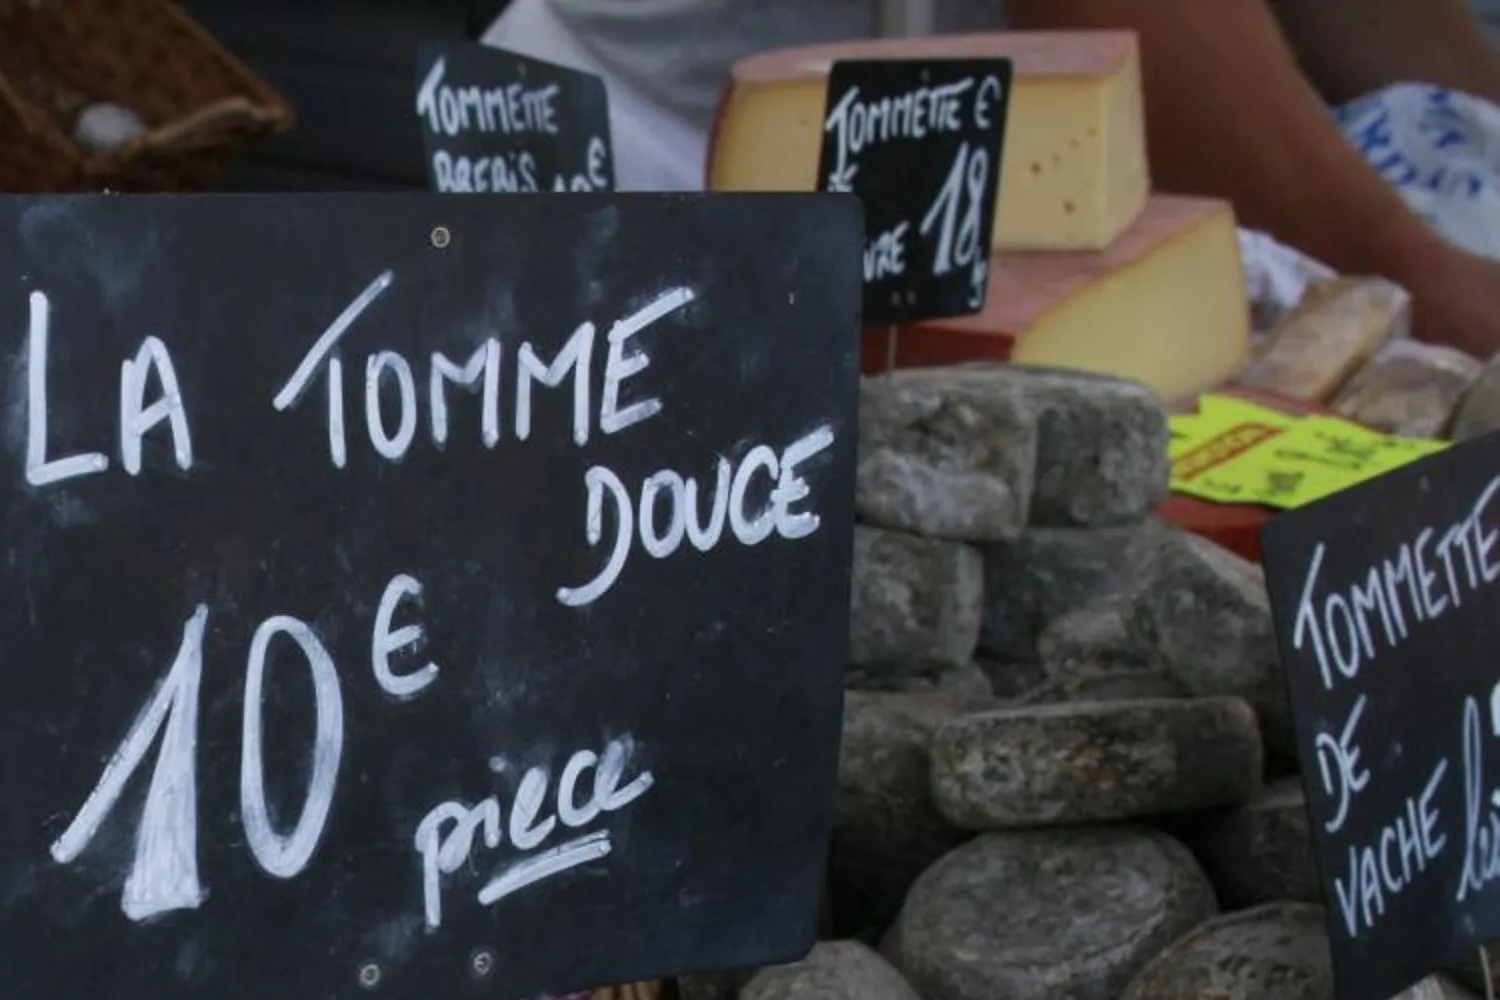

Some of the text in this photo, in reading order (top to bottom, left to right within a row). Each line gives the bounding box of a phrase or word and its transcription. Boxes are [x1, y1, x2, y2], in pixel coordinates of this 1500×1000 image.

[416, 56, 560, 136] TOMMETTE
[825, 77, 974, 178] TOMMETTE
[26, 270, 695, 486] LA TOMME
[557, 425, 835, 606] DOUCE
[1315, 694, 1371, 833] DE
[1334, 757, 1449, 937] VACHE
